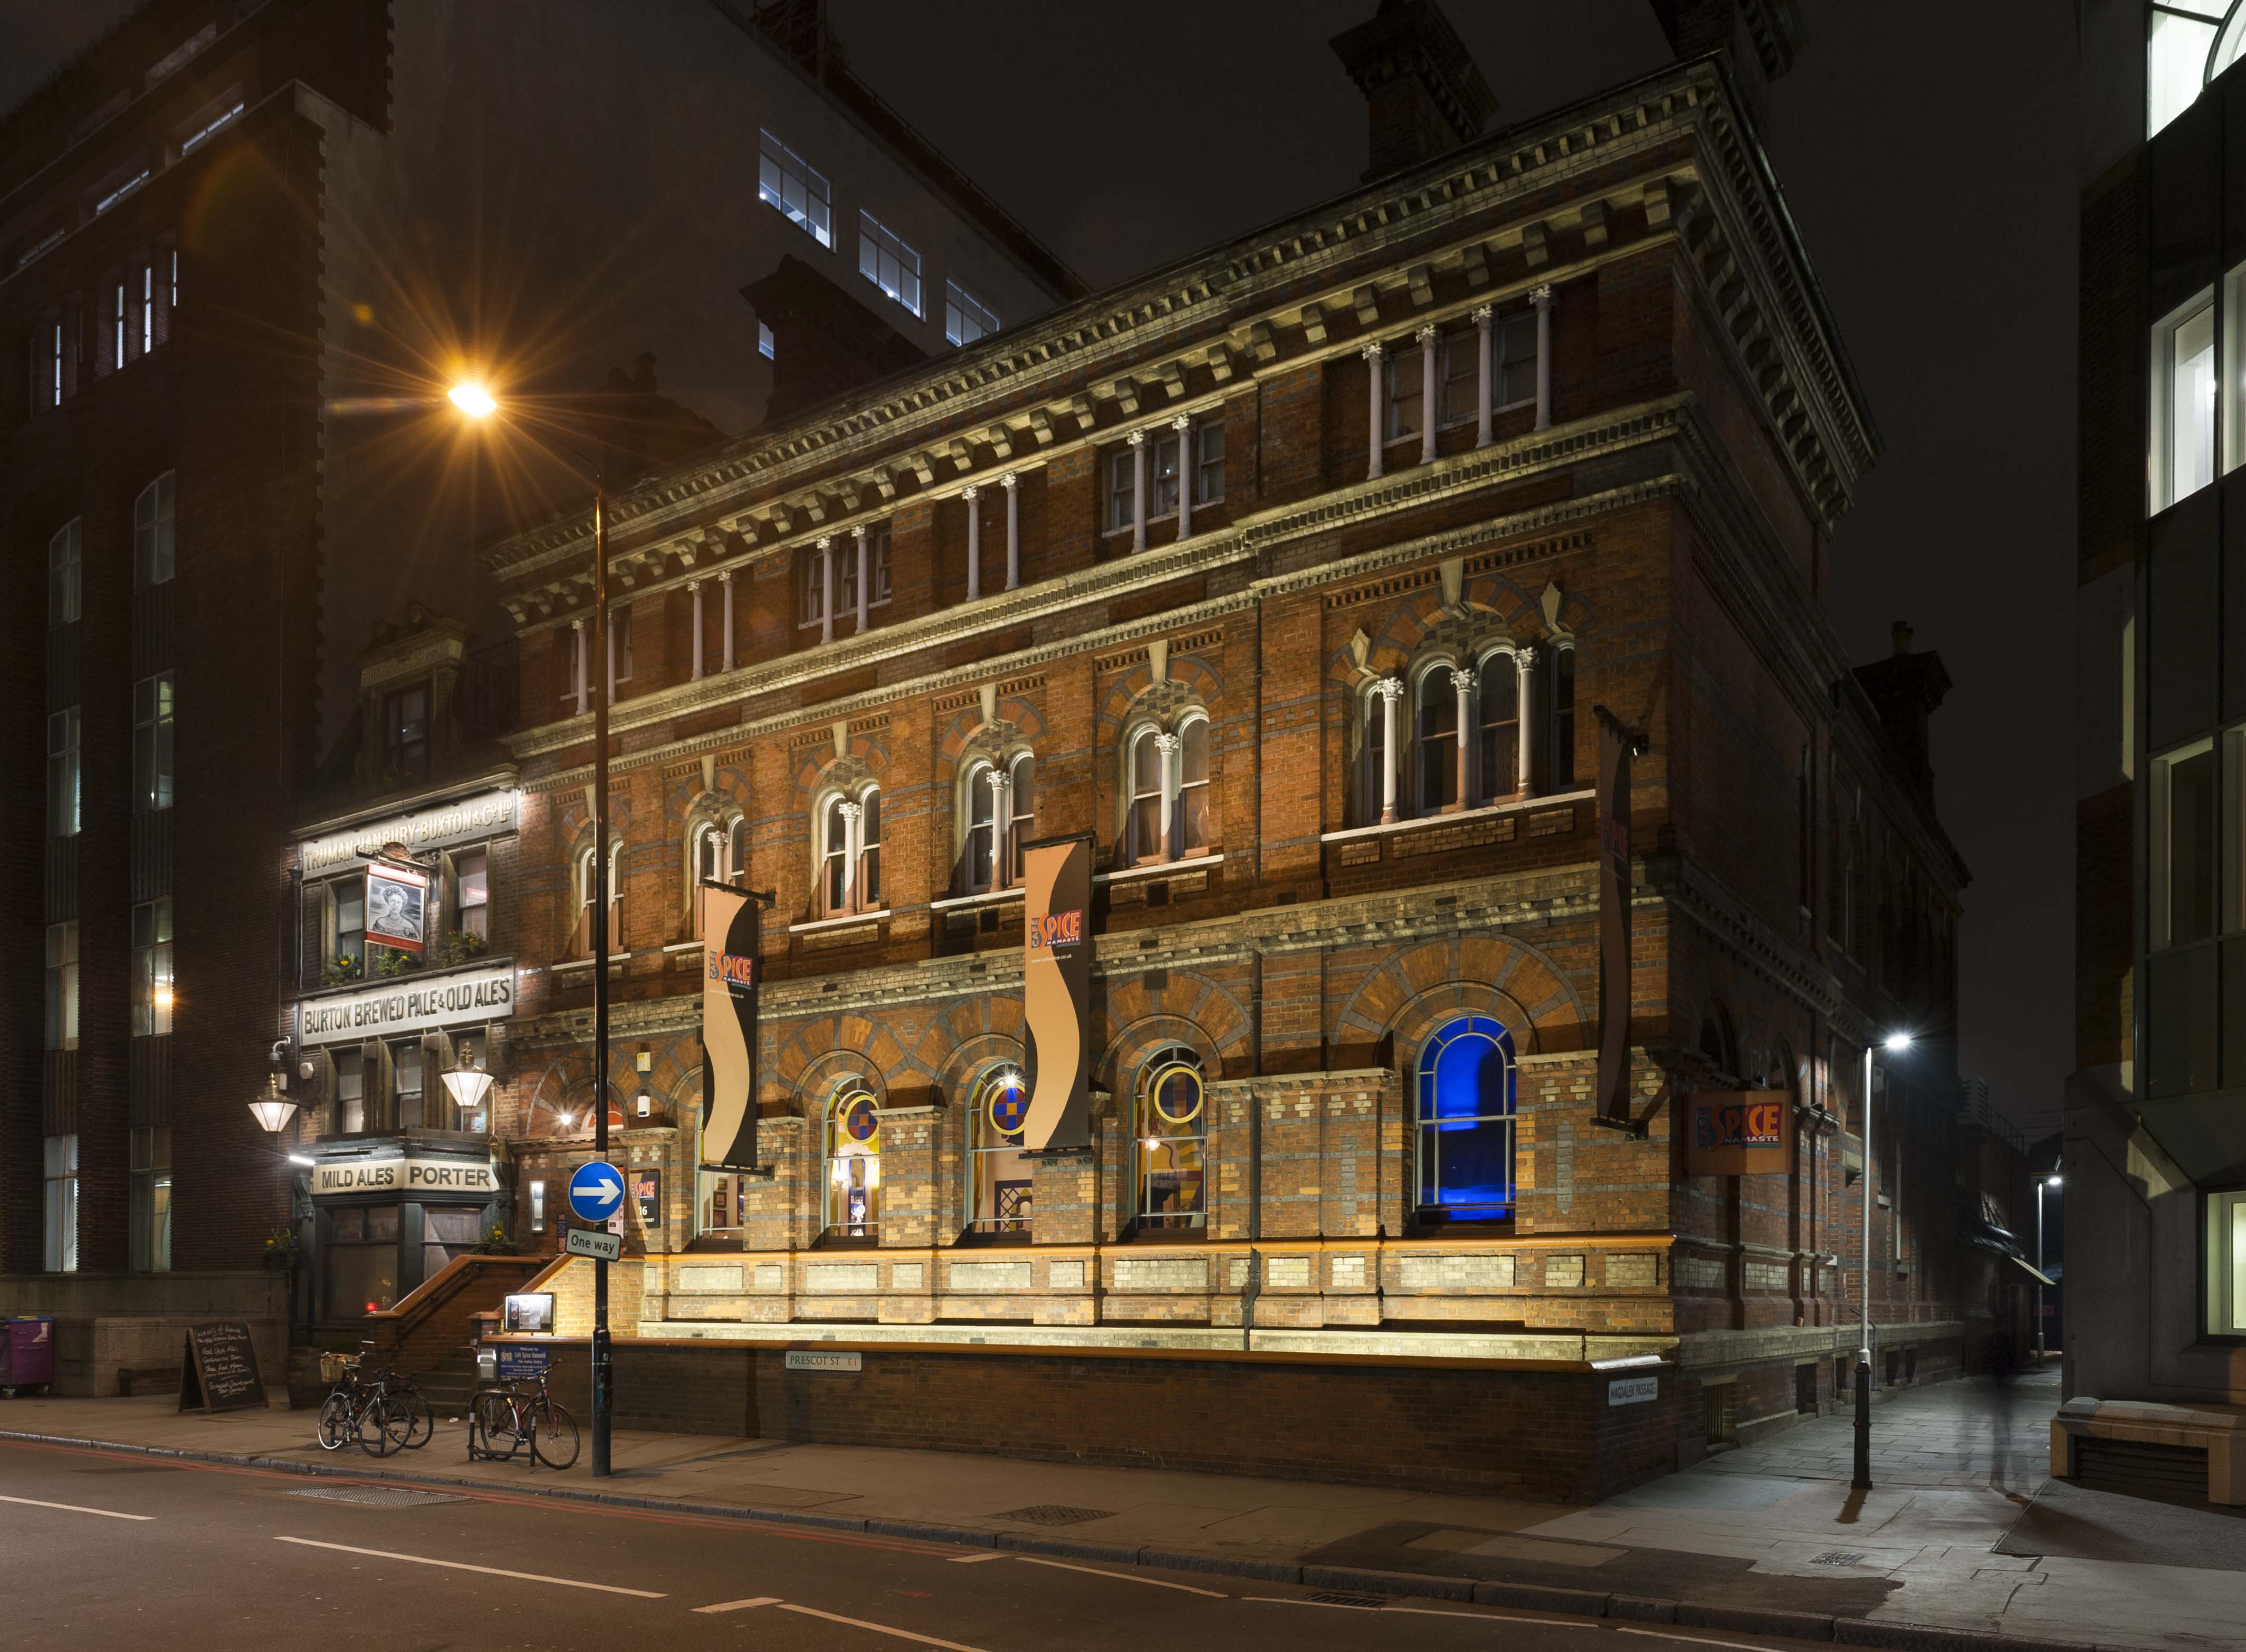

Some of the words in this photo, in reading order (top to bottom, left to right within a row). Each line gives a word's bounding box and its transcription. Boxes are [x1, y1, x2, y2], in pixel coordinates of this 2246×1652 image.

[305, 840, 354, 870] TRUMAN
[421, 808, 473, 843] BUXTON
[474, 811, 481, 825] &
[1038, 912, 1080, 950] SPICE
[715, 949, 750, 982] SPICE
[304, 1005, 351, 1034] BURTON
[355, 995, 404, 1026] BREWED
[407, 989, 437, 1018] PALE
[438, 993, 446, 1009] &
[447, 984, 472, 1012] OLD
[474, 978, 510, 1007] ALES
[1710, 1102, 1780, 1151] SPICE
[322, 1169, 353, 1189] MILD
[357, 1166, 394, 1186] ALES
[409, 1166, 490, 1187] PORTER
[635, 1180, 655, 1199] SPICE
[638, 1206, 648, 1216] 16
[571, 1234, 591, 1248] One
[594, 1240, 615, 1255] way
[790, 1355, 828, 1366] PRESCOT
[830, 1356, 840, 1366] ST
[1610, 1384, 1635, 1400] MAGDALEN
[1636, 1381, 1655, 1398] PASSAGE
